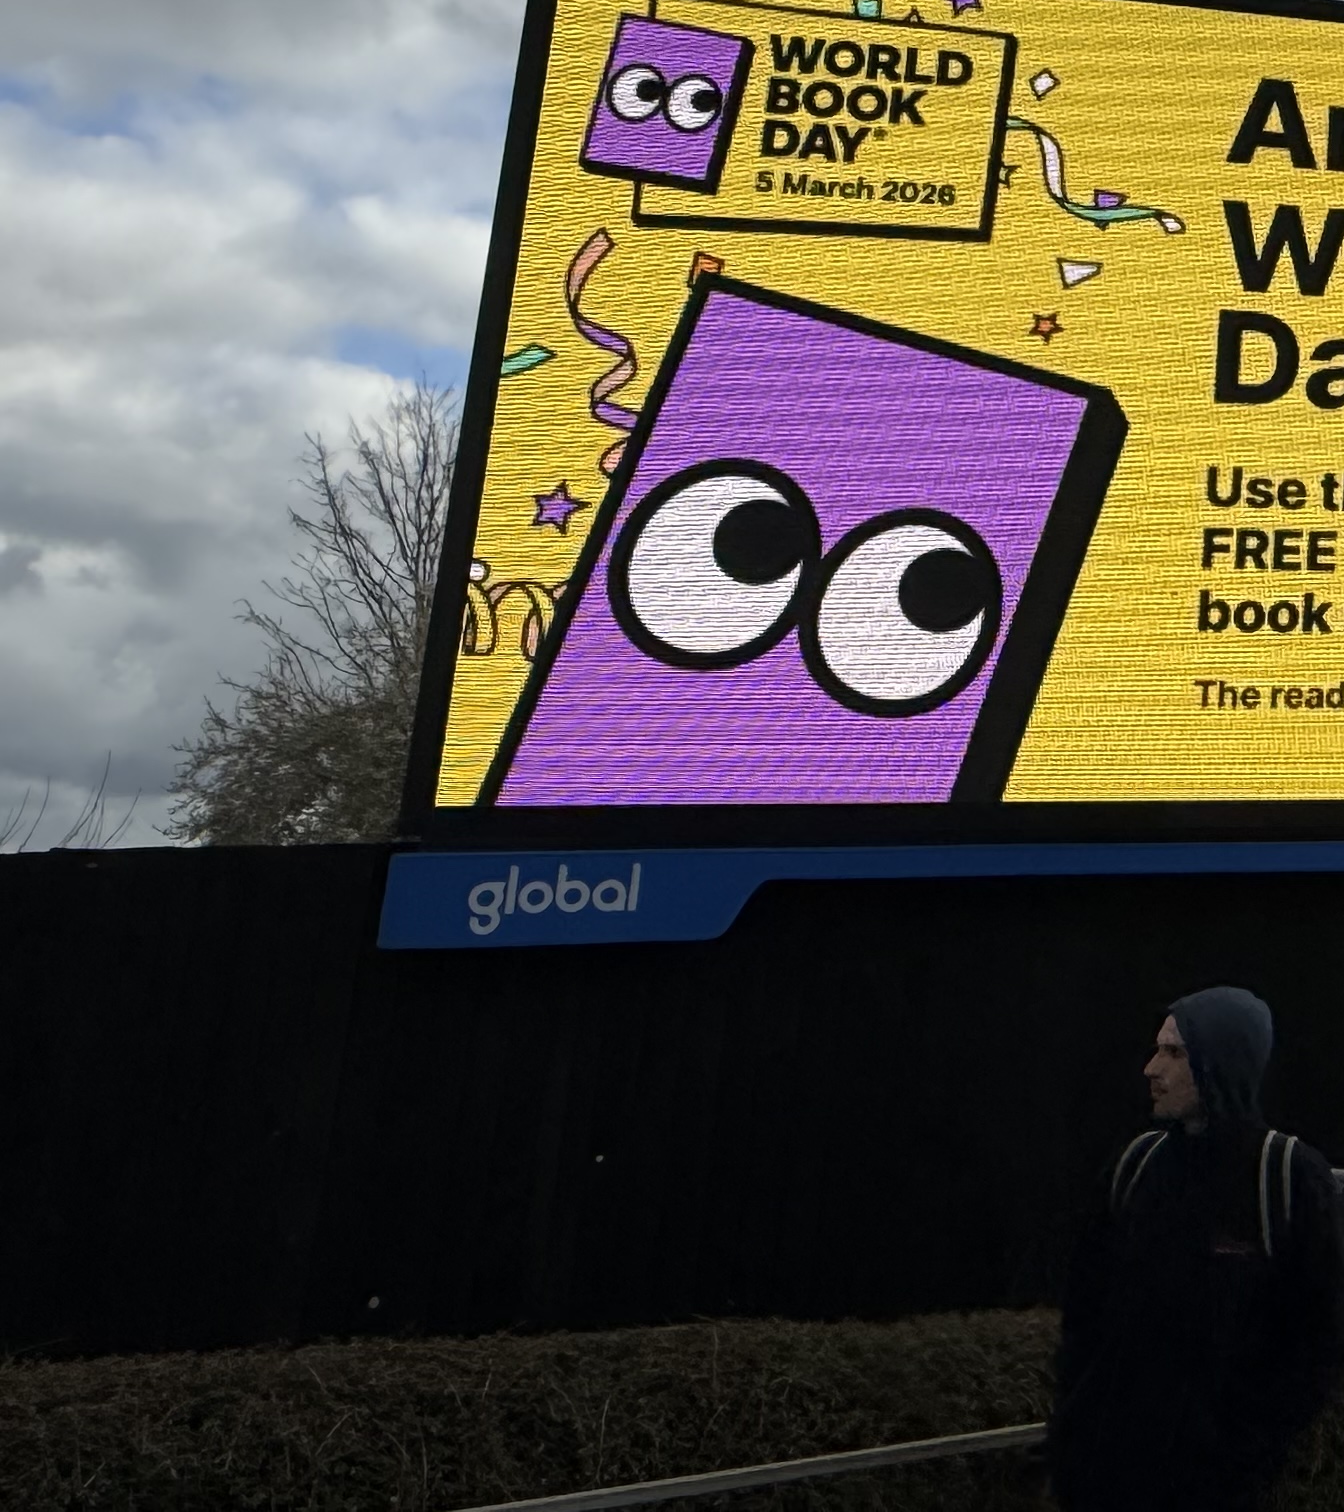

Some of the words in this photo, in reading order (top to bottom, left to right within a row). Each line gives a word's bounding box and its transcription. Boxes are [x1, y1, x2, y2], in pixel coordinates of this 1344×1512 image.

[769, 34, 973, 86] WORLD
[766, 76, 928, 126] BOOK
[756, 171, 775, 193] 5
[782, 172, 874, 201] March
[1207, 466, 1307, 510] Use
[1202, 528, 1337, 573] FREE
[1198, 590, 1332, 634] book
[1194, 680, 1260, 710] The
[468, 863, 641, 935] global
